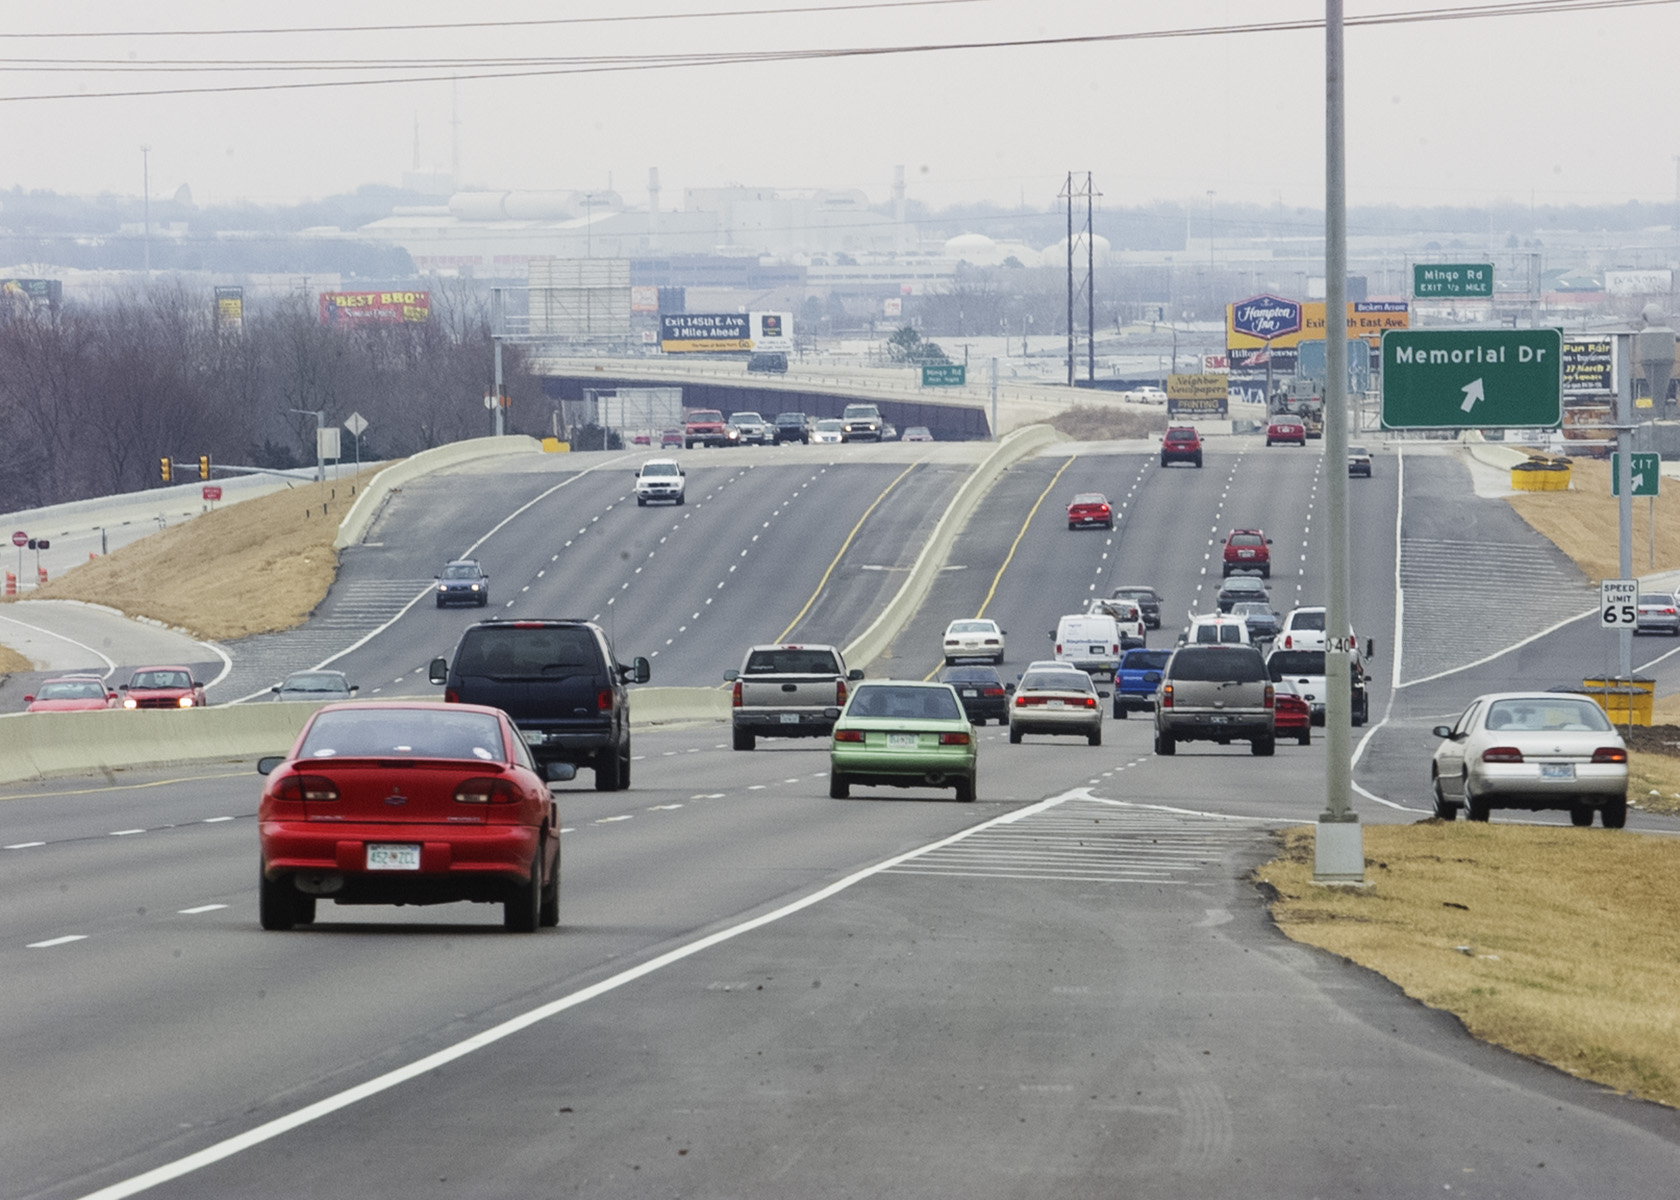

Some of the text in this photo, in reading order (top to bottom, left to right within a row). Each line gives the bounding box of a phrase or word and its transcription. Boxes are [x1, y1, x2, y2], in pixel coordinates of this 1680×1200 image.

[1424, 269, 1483, 282] Mingo Rd
[1420, 283, 1442, 292] EXIT
[1465, 283, 1486, 292] MILE
[1240, 306, 1294, 321] Hampton
[664, 317, 685, 327] Exit
[1252, 319, 1280, 332] Inn
[1306, 318, 1325, 328] Exit
[1360, 318, 1381, 328] East
[1384, 317, 1407, 327] Ave.
[681, 327, 708, 337] Miles
[1563, 344, 1585, 352] Fun
[1395, 345, 1505, 364] Memorial
[1518, 345, 1546, 363] Dr
[1631, 459, 1653, 470] XIT
[1604, 584, 1636, 593] SPEED
[1607, 594, 1632, 603] LIMIT
[1603, 605, 1636, 623] 65
